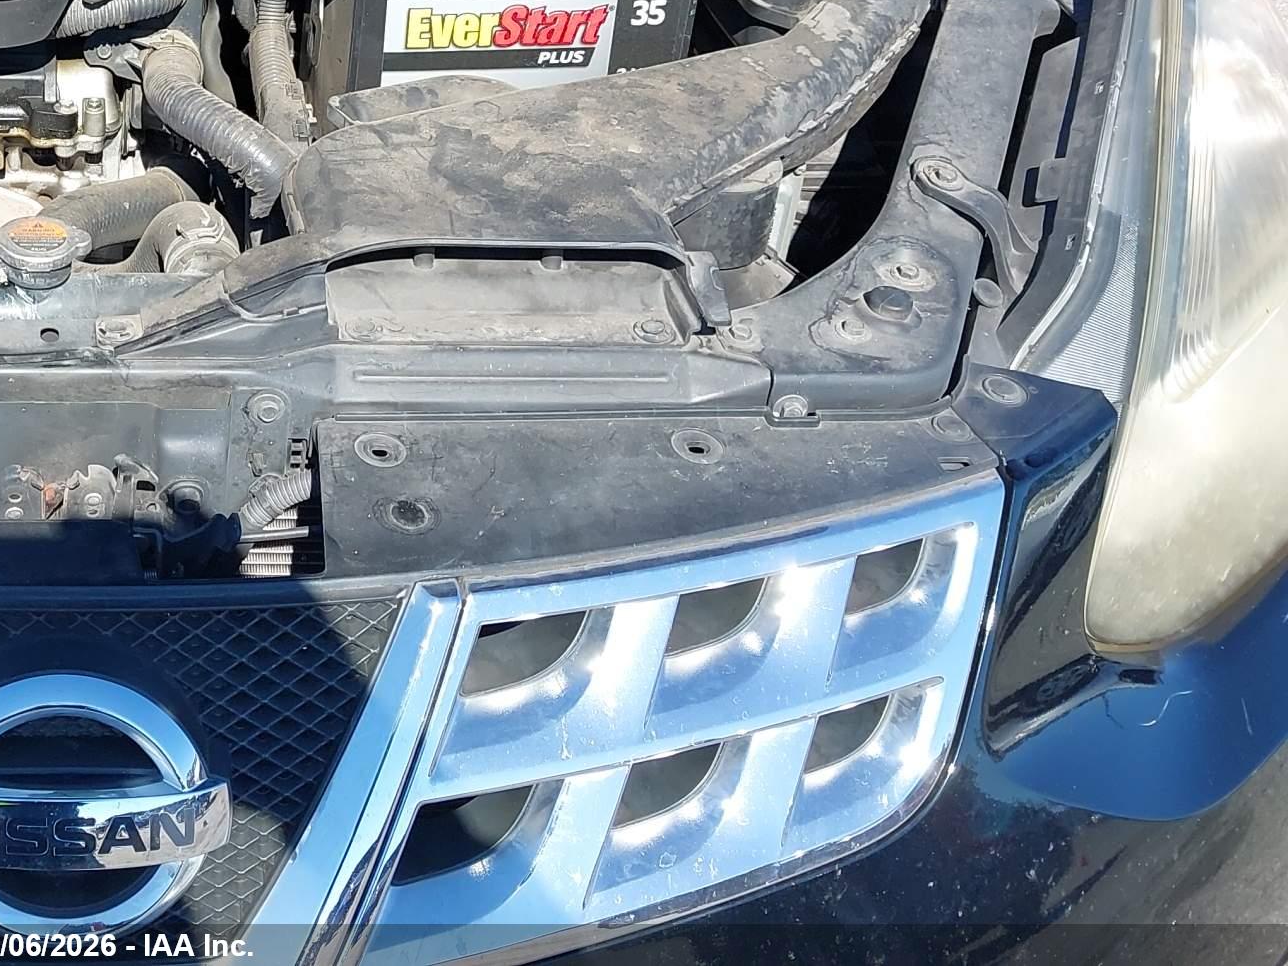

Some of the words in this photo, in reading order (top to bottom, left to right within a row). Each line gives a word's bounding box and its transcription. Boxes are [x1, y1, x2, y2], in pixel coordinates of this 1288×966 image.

[630, 0, 667, 26] 35
[405, 3, 610, 50] EverStart
[537, 49, 586, 65] PLUS
